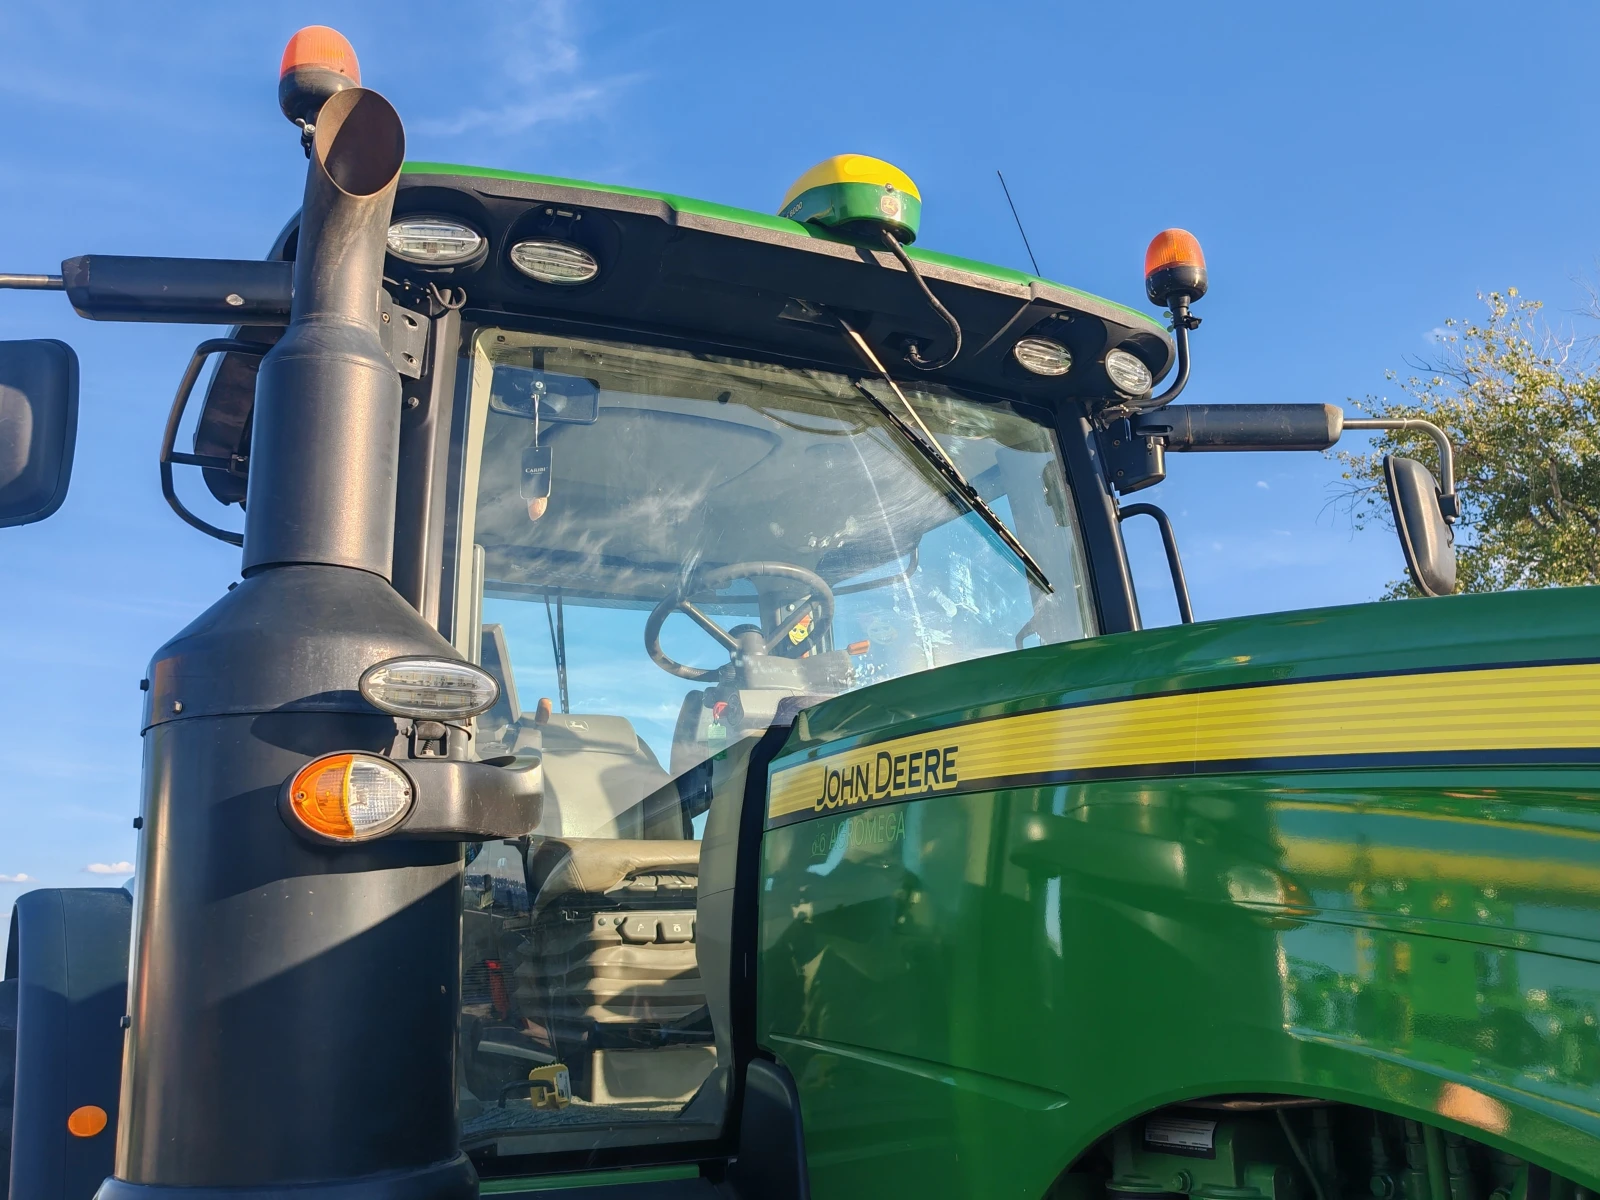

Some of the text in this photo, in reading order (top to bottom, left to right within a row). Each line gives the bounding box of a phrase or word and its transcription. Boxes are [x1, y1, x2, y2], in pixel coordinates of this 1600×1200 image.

[789, 201, 803, 218] 6000
[816, 745, 959, 806] JOHN DEERE
[828, 811, 906, 850] AGROMEGA
